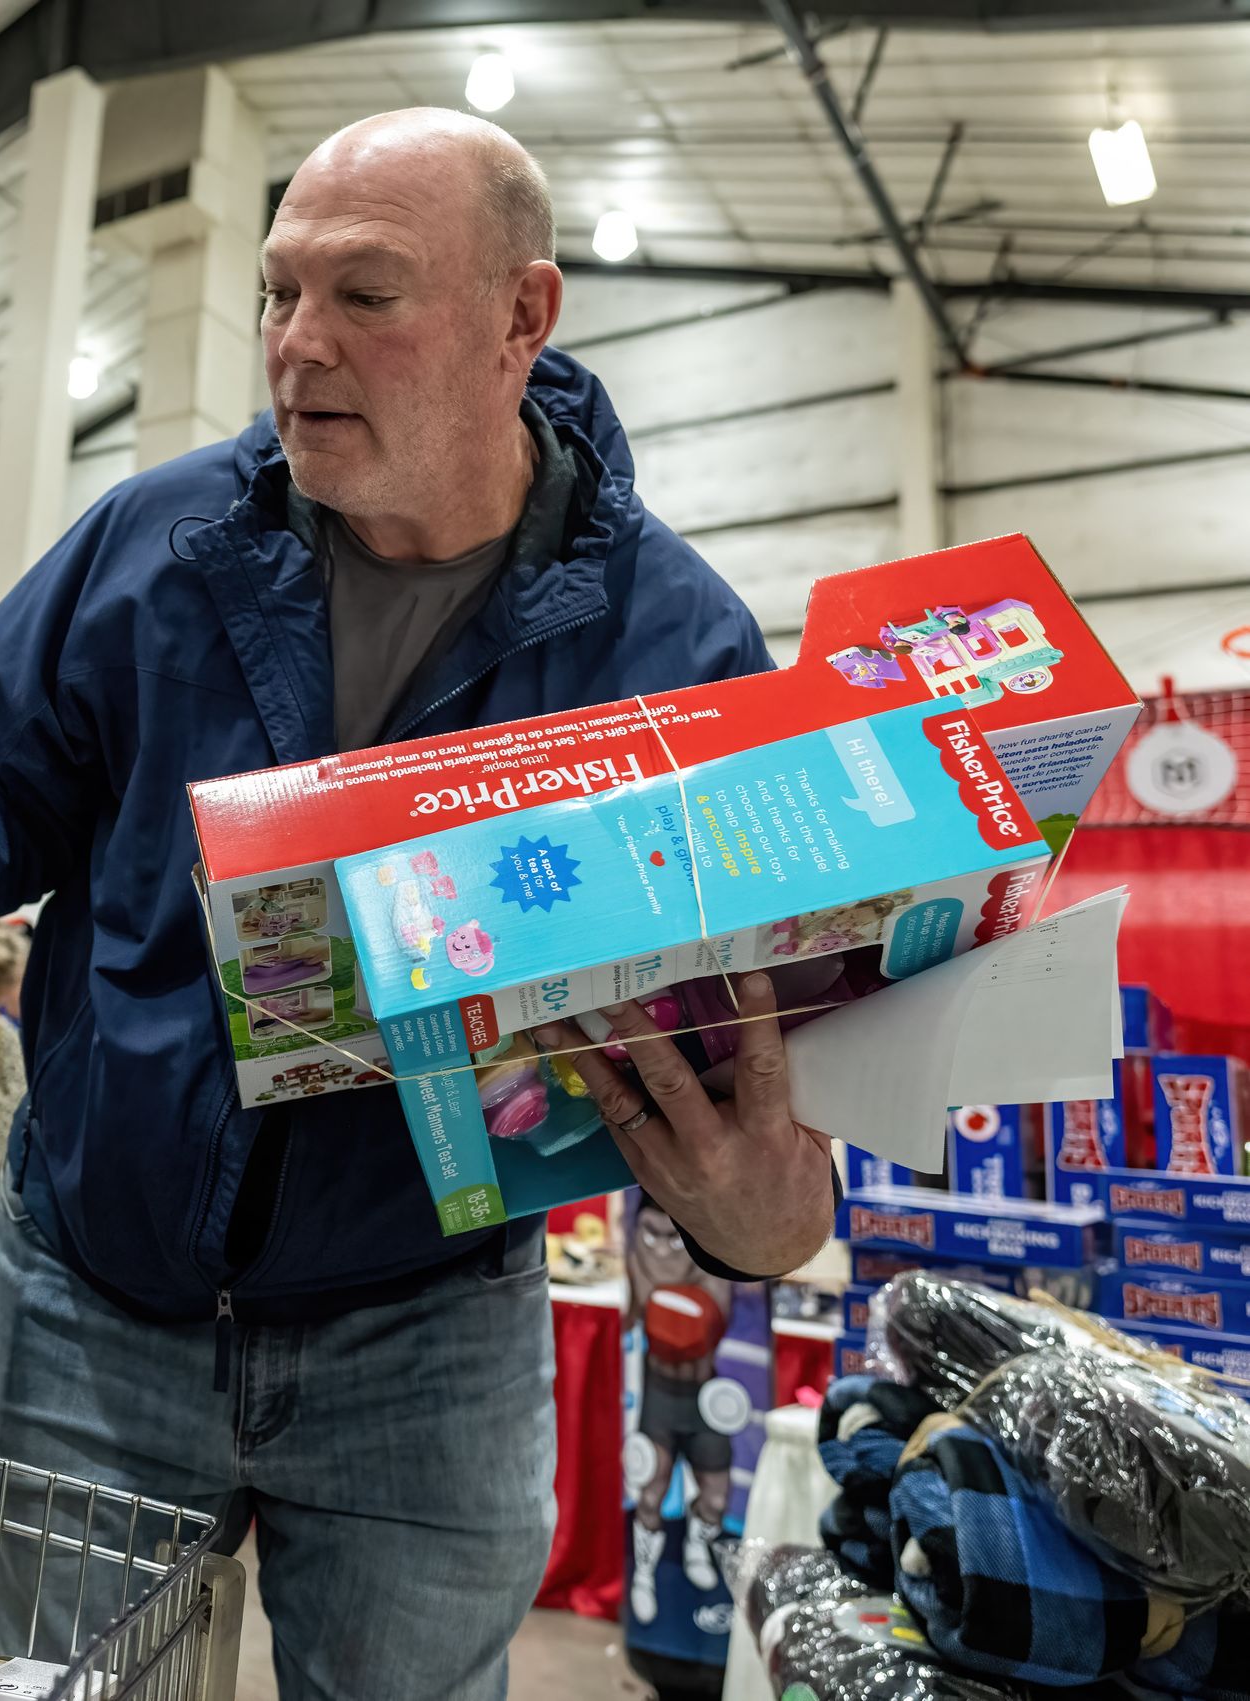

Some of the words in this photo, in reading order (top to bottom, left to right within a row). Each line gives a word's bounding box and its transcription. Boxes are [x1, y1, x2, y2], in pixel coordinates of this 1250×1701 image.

[660, 717, 670, 725] a
[671, 713, 691, 724] for
[690, 707, 722, 720] Time
[514, 732, 528, 742] la
[527, 729, 544, 740] de
[544, 721, 588, 736] L'heure
[581, 730, 604, 742] Set
[604, 725, 628, 738] Gift
[1019, 737, 1037, 746] fun
[1037, 729, 1074, 743] sharing
[1074, 727, 1094, 736] can
[437, 744, 467, 756] Hora
[472, 732, 514, 750] gâterie
[498, 742, 537, 757] regalo
[536, 739, 553, 750] de
[553, 735, 576, 747] Set
[394, 753, 418, 764] uma
[421, 749, 437, 760] de
[442, 750, 499, 768] Heladería
[519, 753, 550, 766] Little
[334, 755, 394, 777] guloseima
[388, 760, 443, 779] Haciendo
[482, 759, 521, 774] People
[846, 737, 867, 752] Hi
[858, 755, 893, 807] there!
[300, 777, 344, 796] Amigos
[344, 771, 389, 786] Nuevos
[413, 752, 645, 817] Fisher-Price
[773, 773, 786, 783] it
[940, 719, 1018, 836] Fisher-Price
[696, 794, 710, 805] &
[779, 784, 798, 808] over
[655, 805, 677, 832] play
[670, 836, 684, 845] &
[754, 780, 775, 805] And,
[767, 806, 792, 845] thanks
[785, 843, 801, 862] for
[791, 810, 805, 823] to
[794, 767, 820, 807] Thanks
[813, 808, 829, 825] for
[822, 827, 850, 870] making
[714, 789, 727, 802] to
[721, 801, 739, 828] help
[733, 829, 762, 875] inspire
[734, 784, 764, 834] choosing
[758, 835, 777, 857] our
[768, 856, 787, 882] toys
[798, 825, 815, 844] the
[701, 806, 741, 877] encourage
[537, 849, 548, 857] A
[701, 855, 713, 868] to
[808, 846, 831, 873] side!
[509, 853, 524, 872] you
[527, 857, 539, 874] tea
[540, 857, 557, 880] spot
[616, 813, 629, 834] Your
[623, 833, 649, 887] Fisher-Price
[644, 885, 662, 915] Family
[518, 873, 529, 881] &
[532, 874, 545, 889] for
[521, 881, 536, 900] me!
[549, 881, 563, 892] of
[992, 871, 1036, 939] Fisher-Pri
[713, 935, 735, 953] Try
[540, 977, 563, 1013] 30+
[415, 1016, 429, 1041] Advanced
[428, 1013, 441, 1036] Counting
[442, 1009, 453, 1031] Manners
[466, 1001, 488, 1046] TEACHES
[390, 1023, 400, 1036] AND
[405, 1031, 414, 1042] Play
[421, 1039, 432, 1057] Shapes
[434, 1038, 445, 1055] Colors
[447, 1033, 458, 1052] Sharing
[447, 1095, 462, 1119] Learn
[424, 1102, 447, 1145] Manners
[436, 1142, 453, 1164] Tea
[441, 1161, 460, 1180] Set
